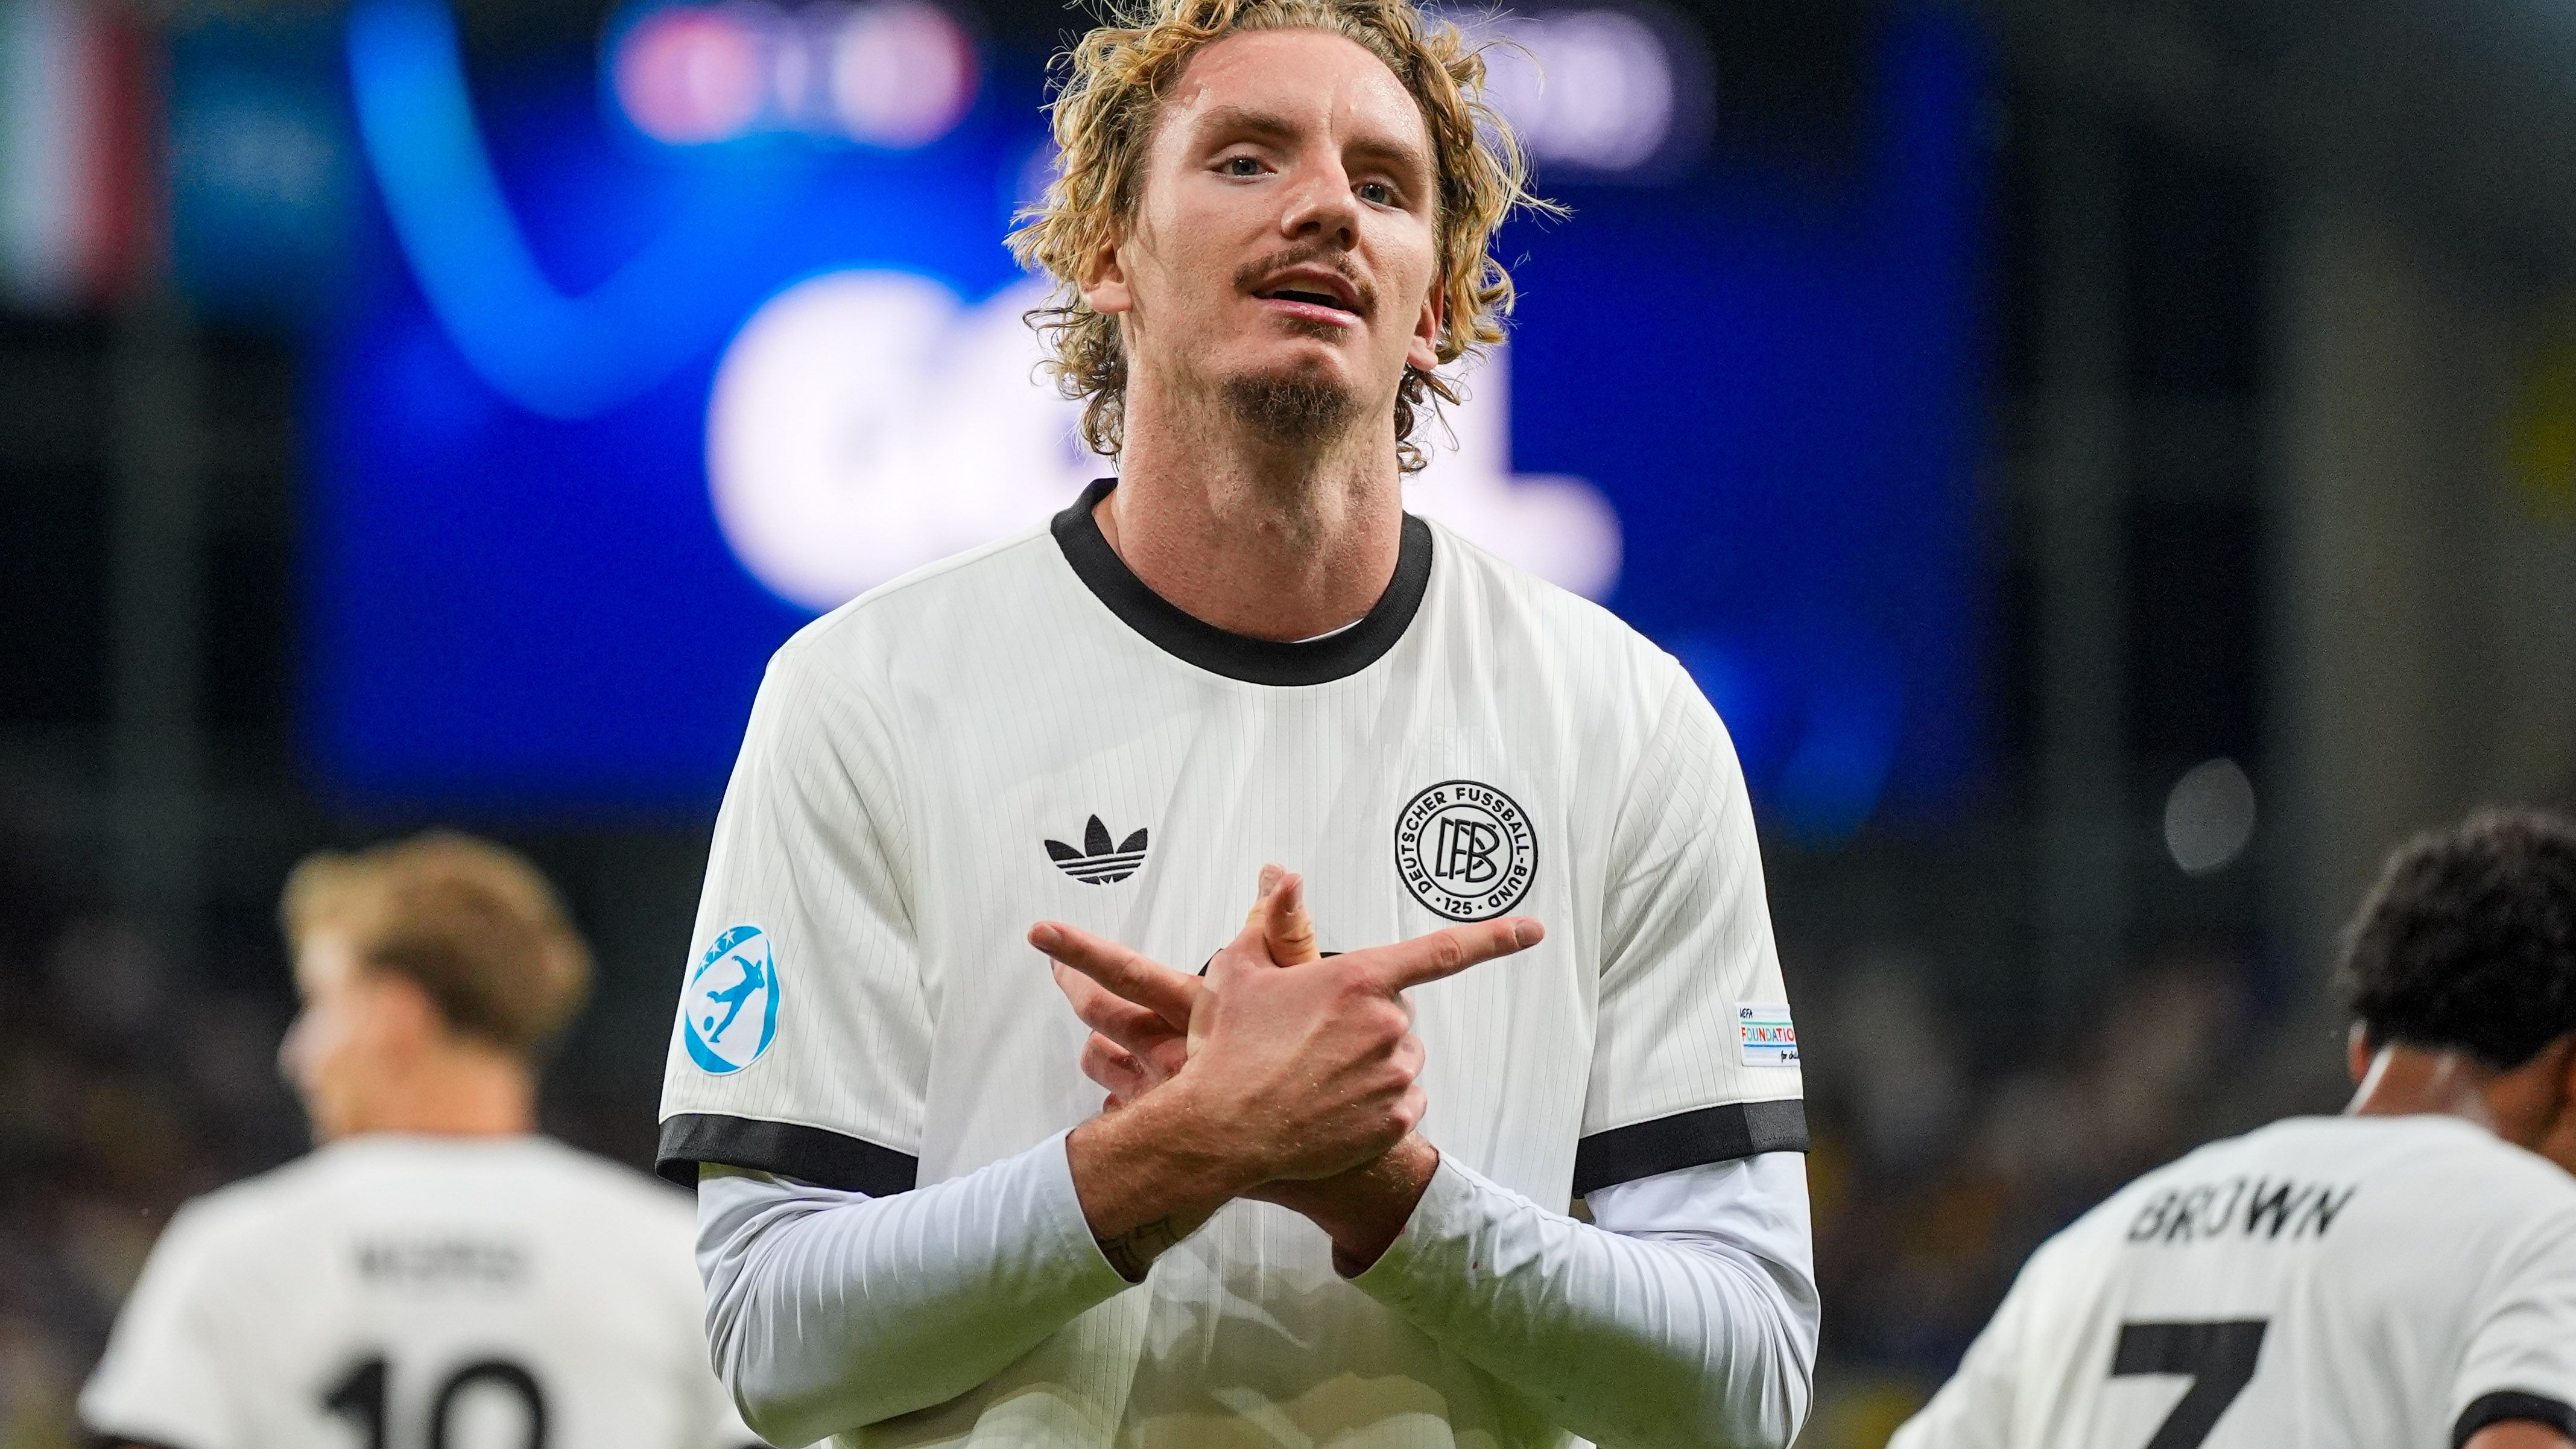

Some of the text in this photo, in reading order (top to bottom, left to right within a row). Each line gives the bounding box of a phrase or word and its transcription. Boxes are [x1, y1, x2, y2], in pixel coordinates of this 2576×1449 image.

[1401, 787, 1530, 908] DEUTSCHER FUSSBALL-BUND
[1444, 896, 1473, 915] 125
[2127, 1175, 2359, 1245] BROWN
[2110, 1317, 2271, 1449] 7
